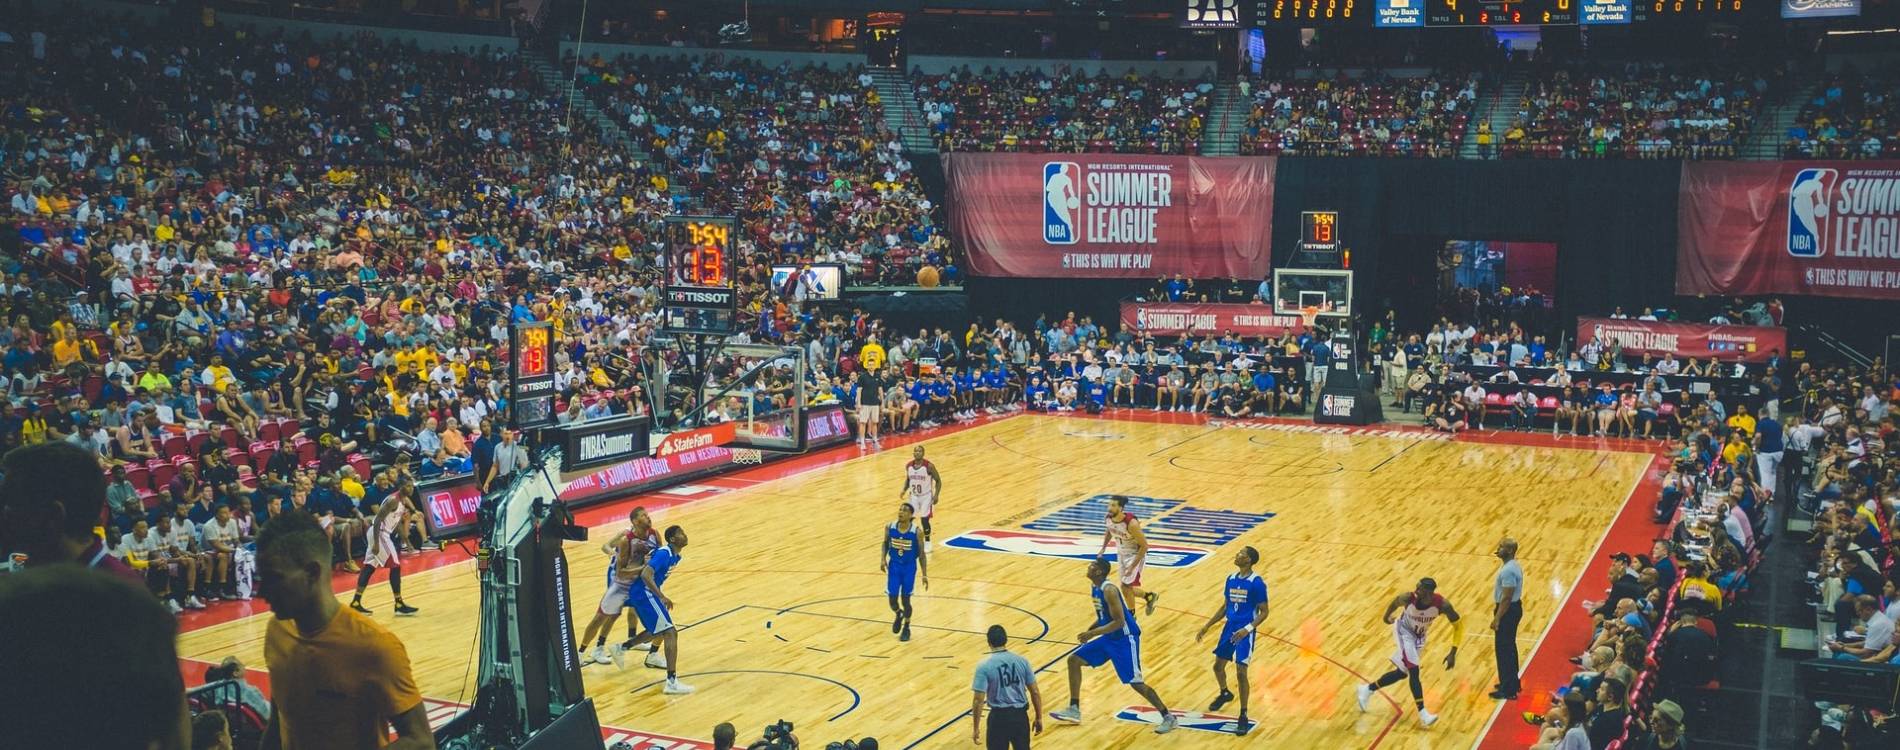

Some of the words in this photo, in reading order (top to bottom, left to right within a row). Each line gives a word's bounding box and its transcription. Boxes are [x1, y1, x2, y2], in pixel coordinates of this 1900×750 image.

[1379, 8, 1400, 16] Valley
[1401, 8, 1419, 16] Bank
[1544, 12, 1550, 22] 2
[1584, 5, 1606, 14] Valley
[1587, 13, 1595, 21] of
[1391, 16, 1416, 24] Nevada
[1481, 13, 1488, 23] 2
[1514, 13, 1521, 22] 2
[1087, 171, 1172, 207] SUMMER
[1087, 207, 1157, 244] LEAGUE
[1313, 214, 1334, 225] 7:54
[688, 223, 728, 247] 7:54
[1048, 224, 1066, 239] NBA
[1314, 225, 1331, 241] 13
[1792, 234, 1811, 250] NBA
[690, 246, 722, 286] 13
[1071, 253, 1091, 269] THIS
[1091, 253, 1100, 269] IS
[1100, 253, 1119, 269] WHY
[1120, 254, 1132, 269] WE
[1133, 254, 1152, 269] PLAY
[1815, 268, 1836, 286] THIS
[1837, 269, 1847, 286] IS
[1848, 269, 1869, 287] WHY
[1870, 270, 1884, 288] WE
[685, 293, 730, 303] TISSOT
[1148, 314, 1185, 330] SUMMER
[1186, 314, 1217, 330] LEAGUE
[1239, 315, 1253, 326] THIS
[1253, 316, 1259, 326] IS
[1260, 316, 1272, 327] WHY
[1272, 316, 1283, 327] WE
[1283, 316, 1297, 328] PLAY
[1645, 334, 1679, 351] LEAGUE
[1708, 334, 1756, 342] #NBASummer
[529, 349, 542, 373] 13
[528, 380, 553, 392] TISSOT
[580, 433, 633, 461] #NBASummer
[606, 457, 643, 486] SUMMER
[642, 456, 672, 477] LEAGUE
[679, 450, 697, 465] MGM
[911, 484, 922, 494] 20
[439, 498, 453, 521] TV
[554, 557, 562, 576] MGM
[556, 577, 565, 611] RESORTS
[559, 611, 572, 671] INTERNATIONAL
[997, 662, 1021, 689] 134
